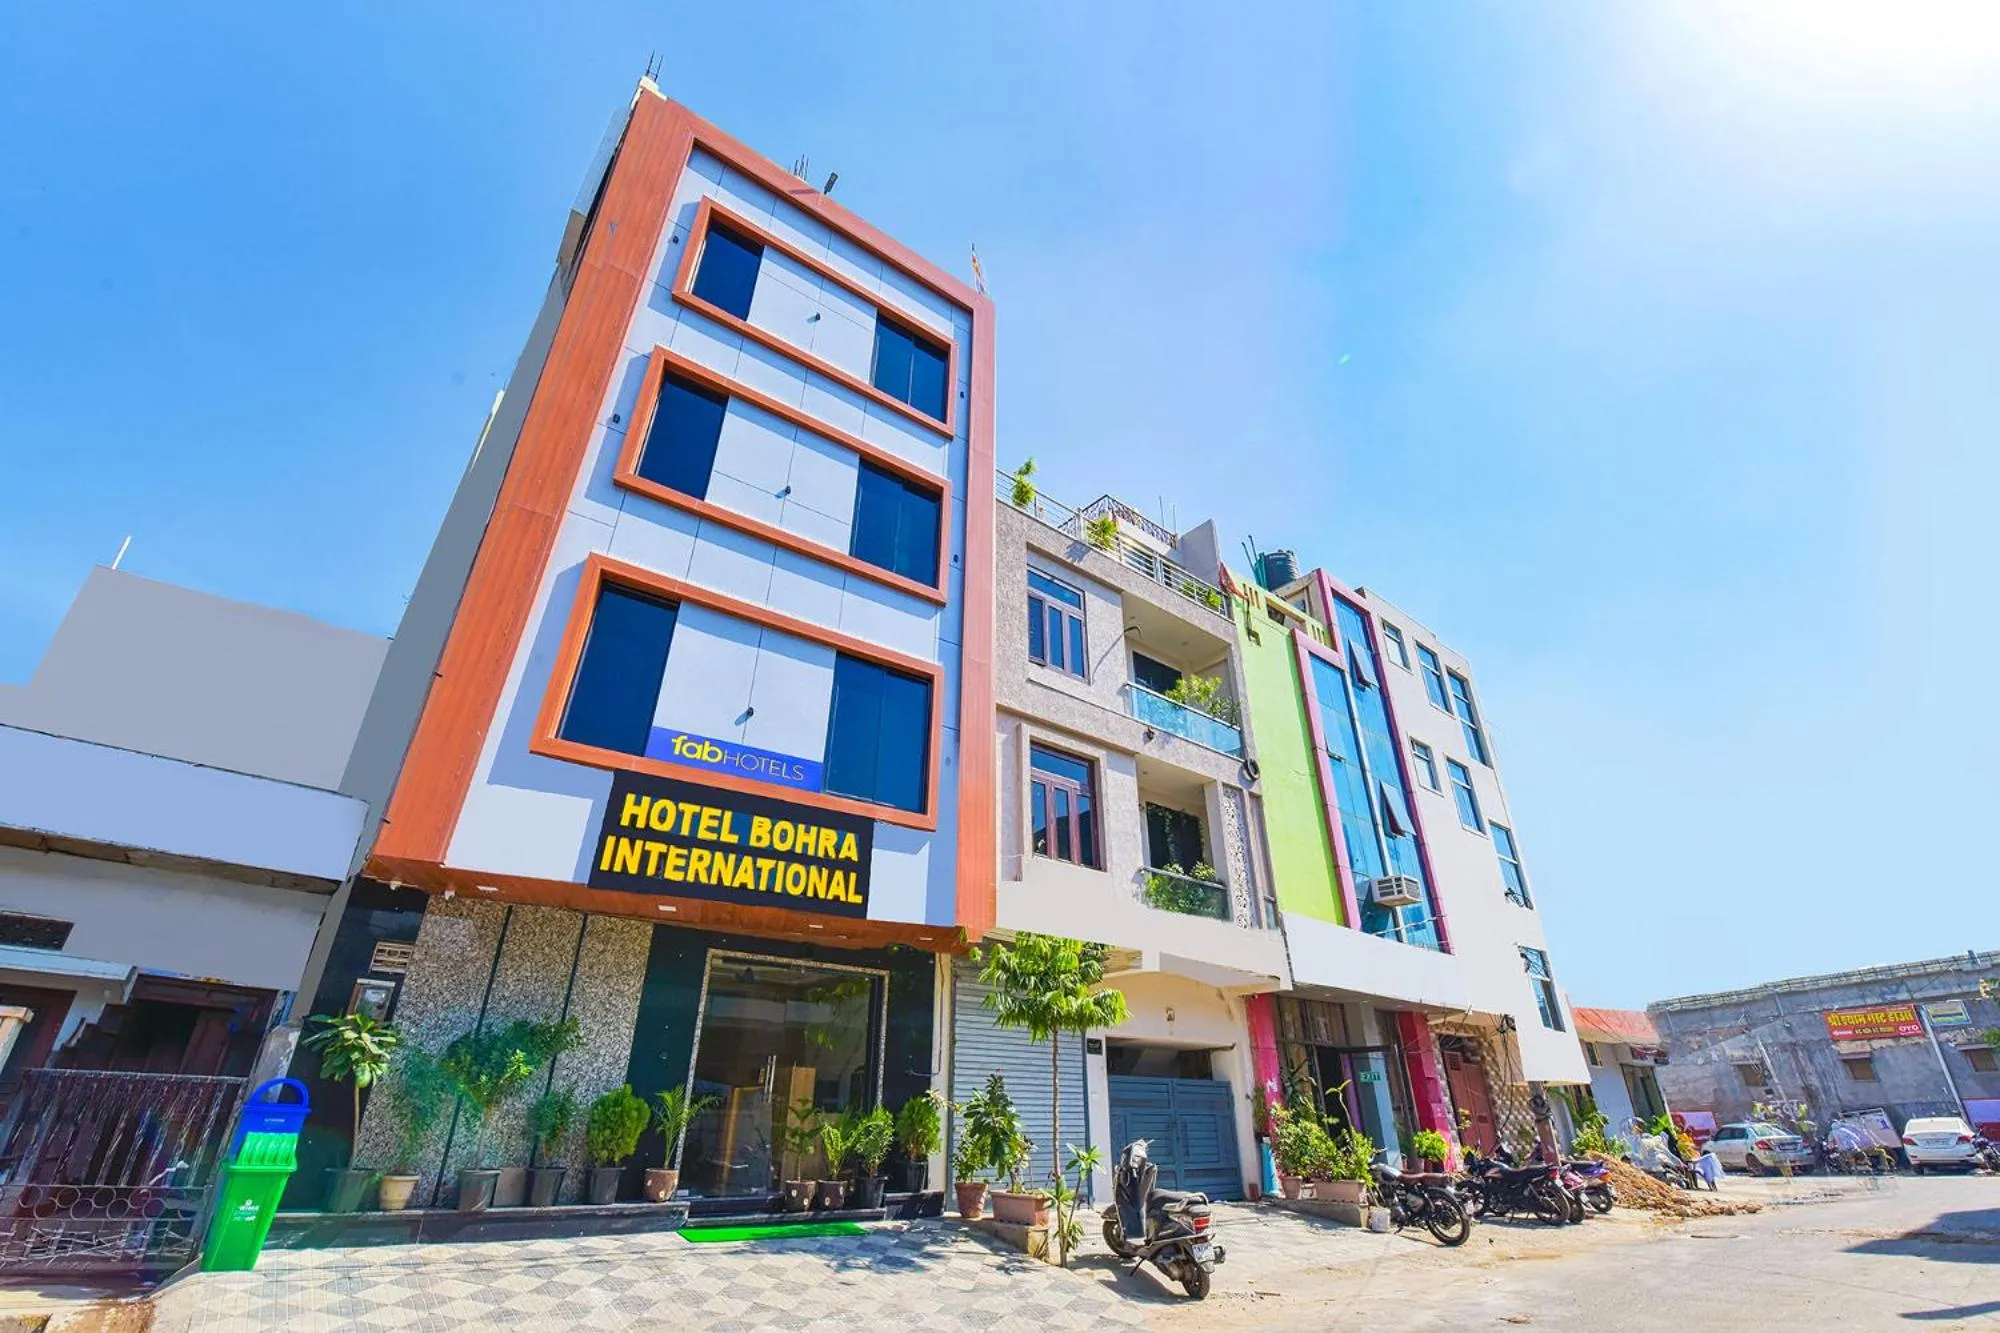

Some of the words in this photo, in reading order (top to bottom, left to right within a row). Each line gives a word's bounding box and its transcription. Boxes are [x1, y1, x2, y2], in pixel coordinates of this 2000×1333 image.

[620, 792, 739, 844] HOTEL
[749, 815, 858, 862] BOHRA
[599, 835, 863, 904] INTERNATIONAL
[1898, 1024, 1919, 1033] OYO
